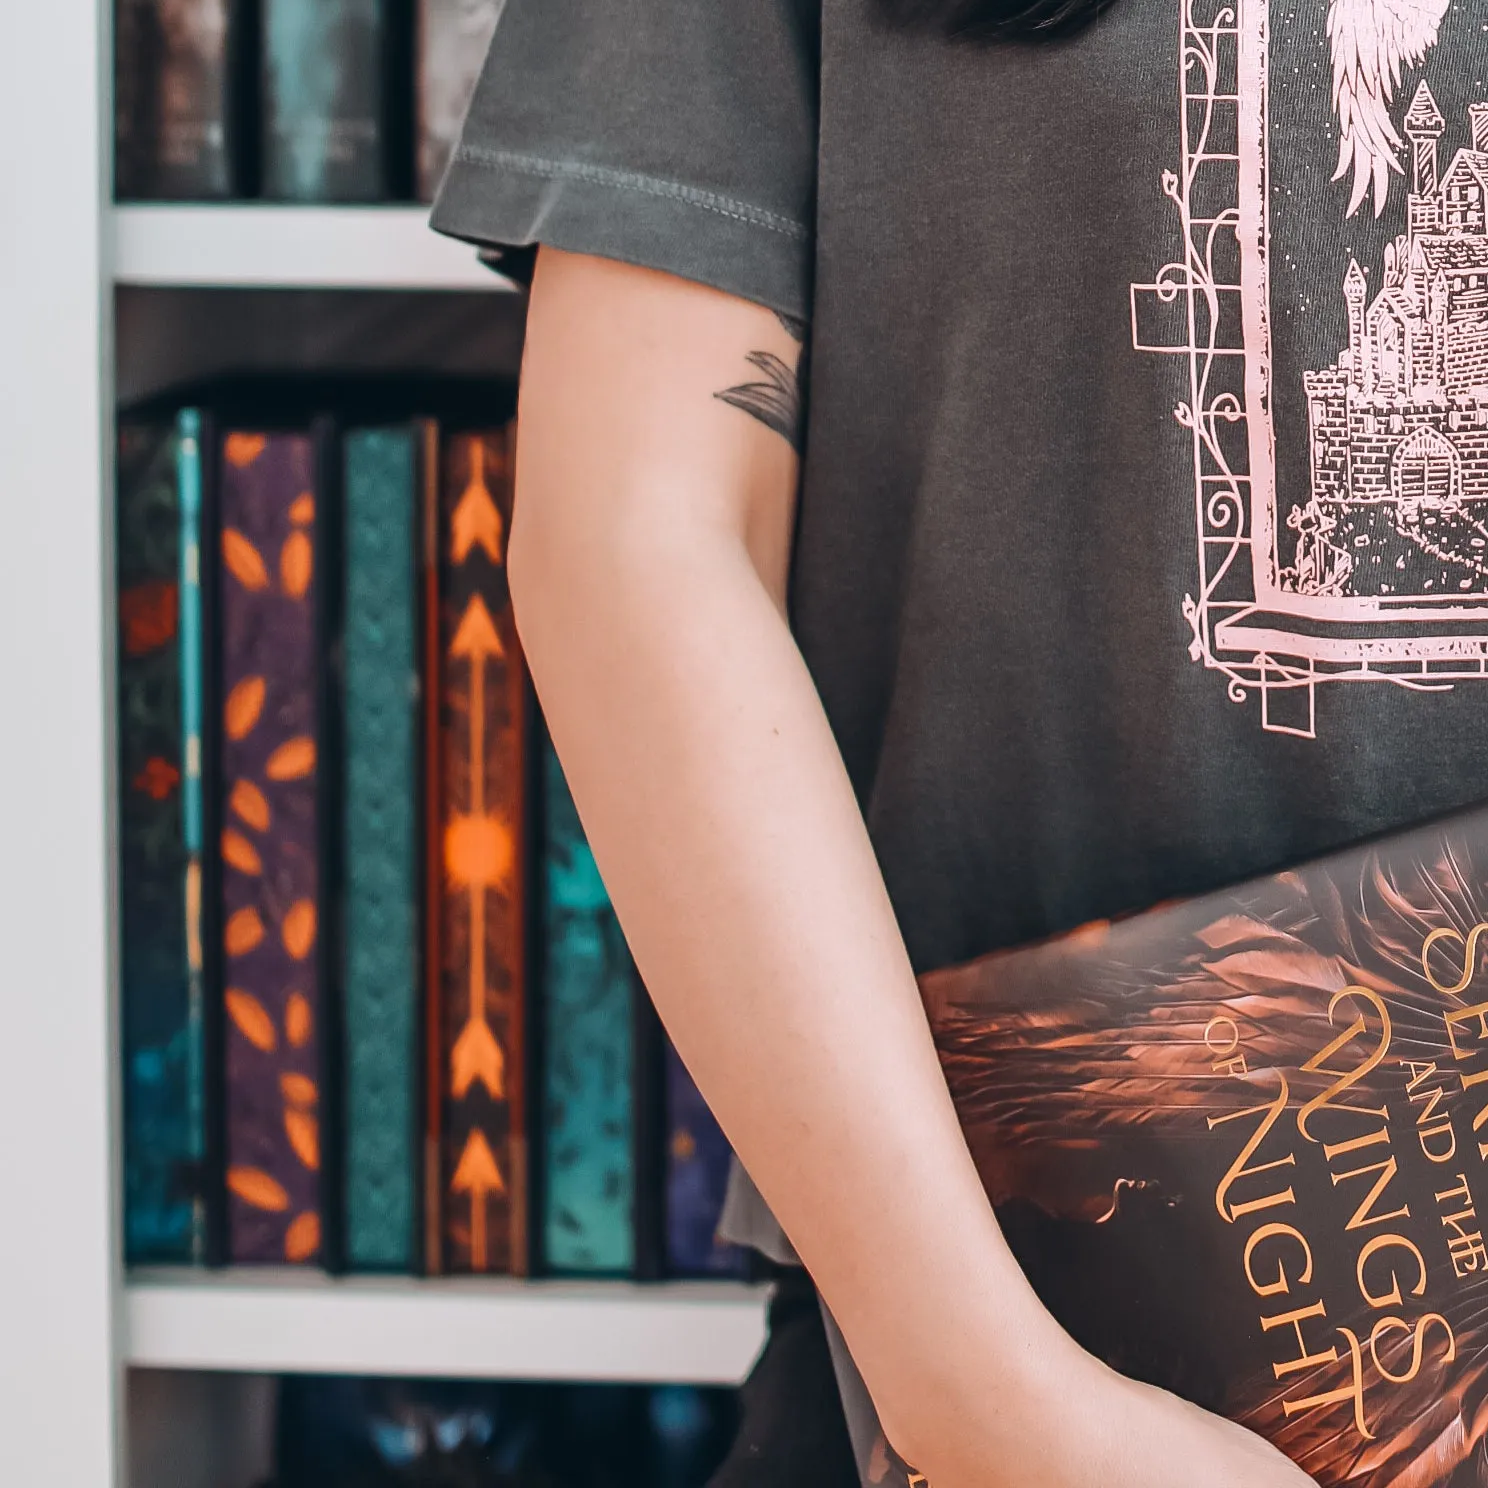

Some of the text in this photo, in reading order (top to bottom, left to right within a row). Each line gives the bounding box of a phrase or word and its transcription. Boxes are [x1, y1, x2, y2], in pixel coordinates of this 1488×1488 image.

[1204, 1015, 1249, 1081] OF
[1399, 1058, 1457, 1163] AND
[1207, 1066, 1377, 1439] NIGHT
[1296, 985, 1456, 1383] WINGS
